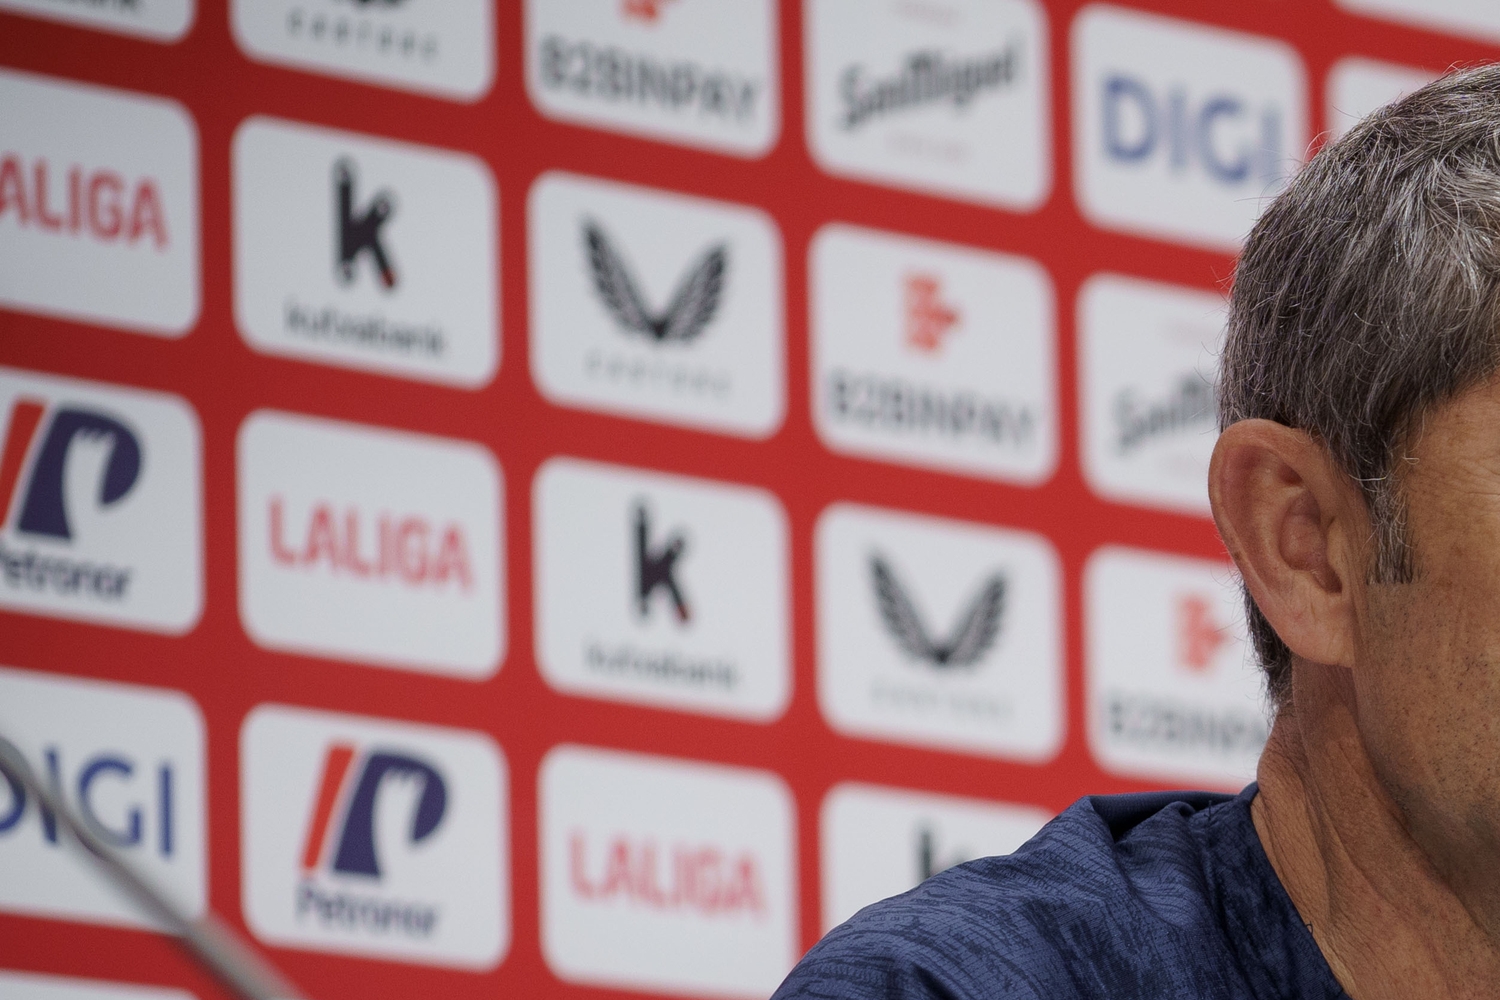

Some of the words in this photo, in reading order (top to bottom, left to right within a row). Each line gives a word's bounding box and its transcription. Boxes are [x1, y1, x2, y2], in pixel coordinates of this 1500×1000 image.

[0, 152, 167, 248] ALIGA
[0, 551, 131, 598] etronor
[267, 494, 474, 592] LALIGA
[568, 832, 768, 918] LALIGA
